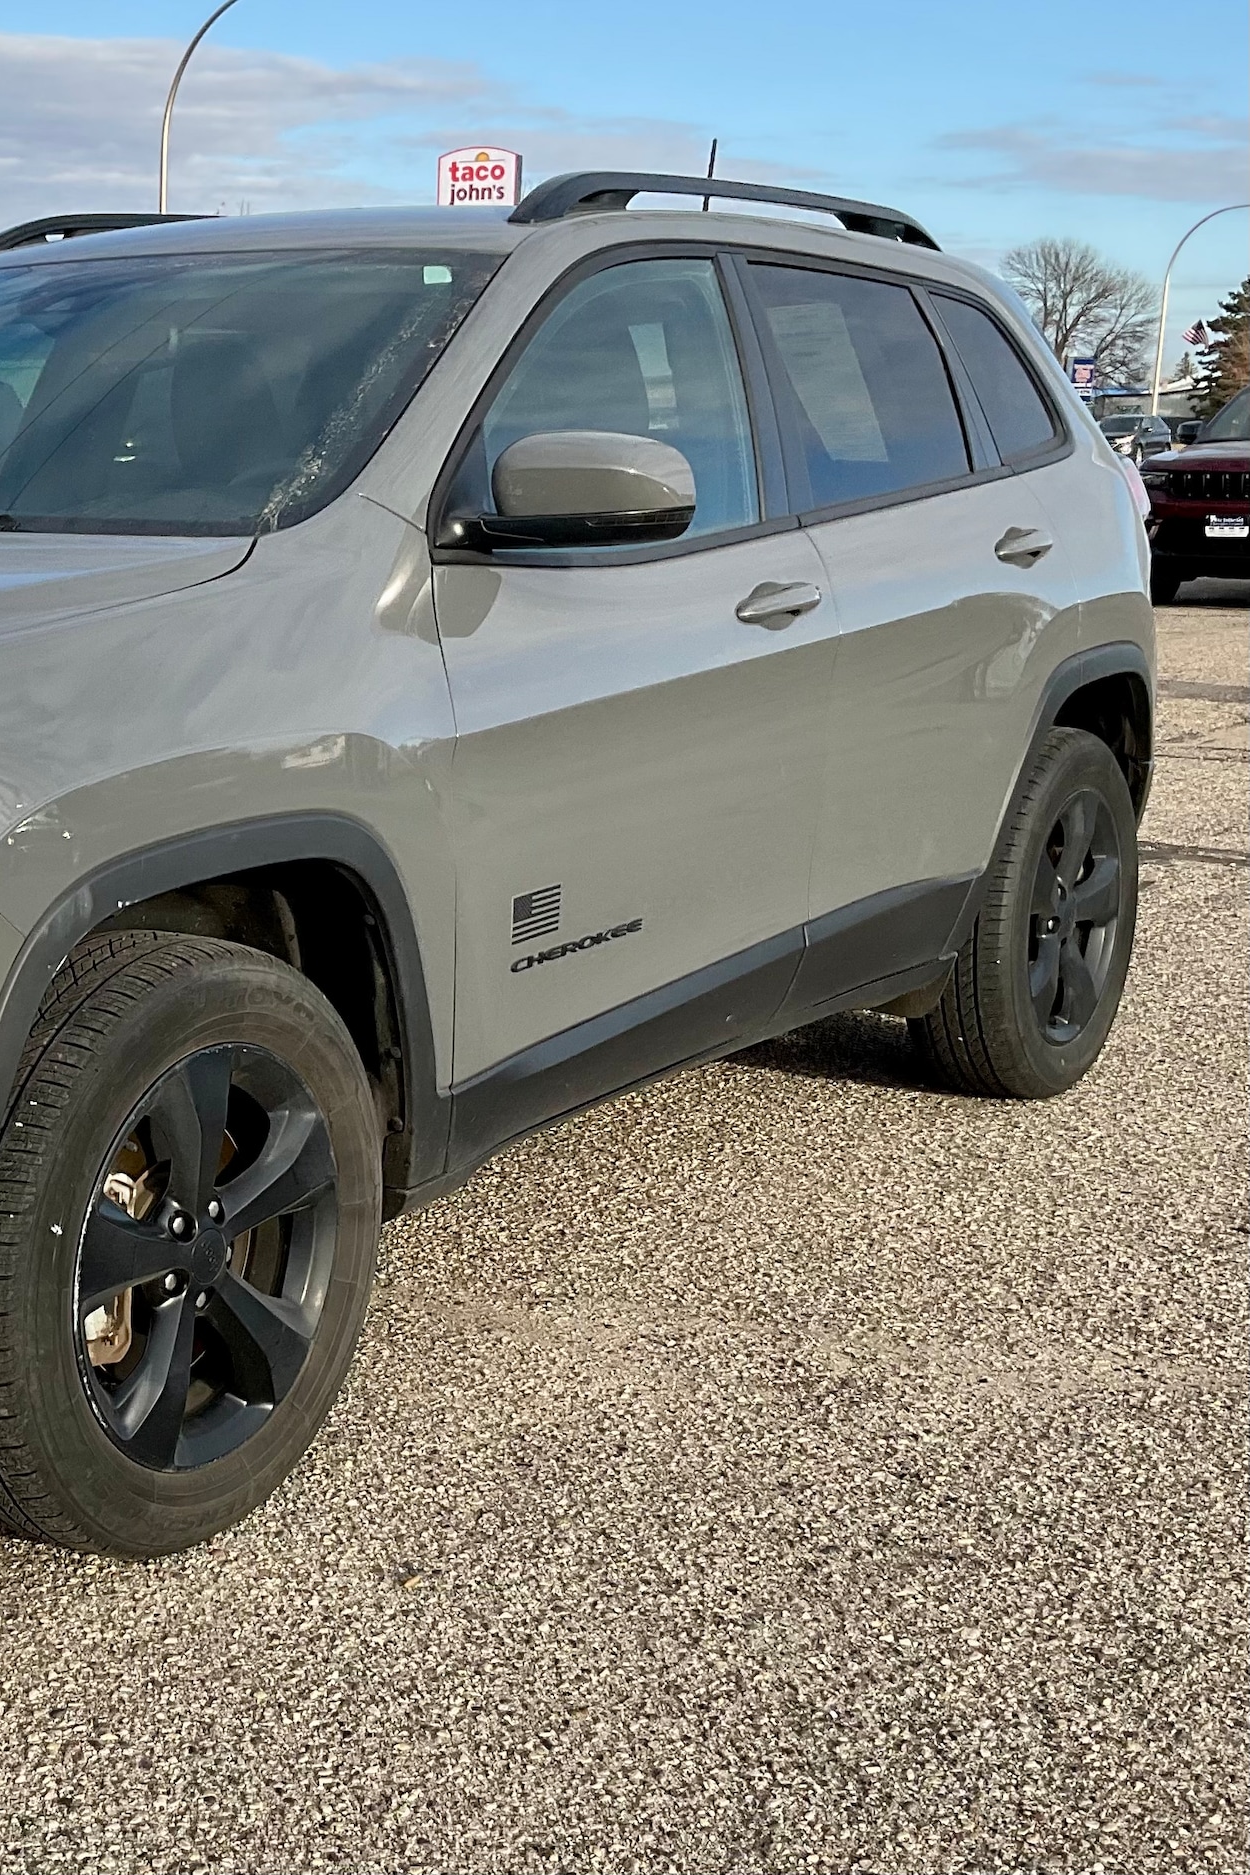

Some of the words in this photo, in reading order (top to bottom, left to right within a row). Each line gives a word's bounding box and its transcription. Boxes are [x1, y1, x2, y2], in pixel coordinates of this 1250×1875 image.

[448, 161, 505, 182] taco
[449, 184, 504, 206] john's
[510, 918, 643, 973] CHEROKEE
